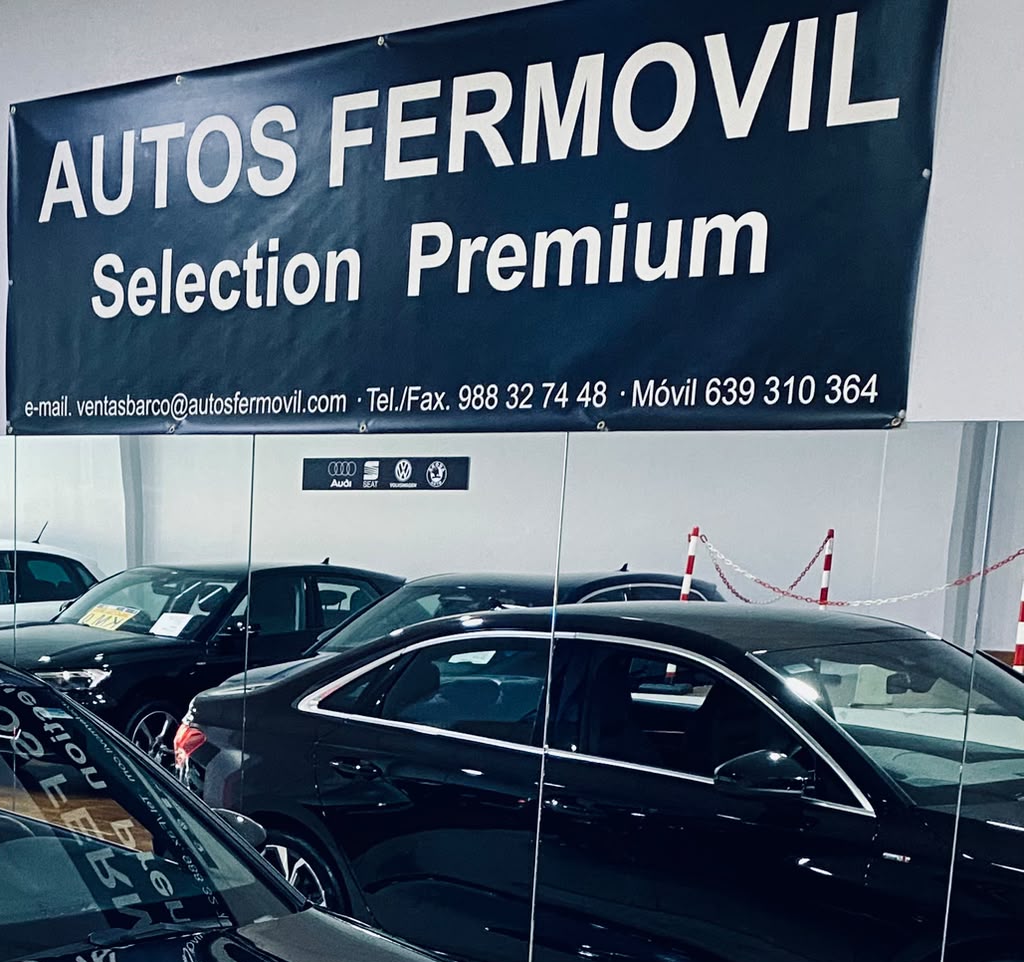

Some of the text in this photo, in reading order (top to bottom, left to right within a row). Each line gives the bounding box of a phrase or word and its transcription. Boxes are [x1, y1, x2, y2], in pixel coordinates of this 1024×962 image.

[39, 11, 900, 223] AUTOS FERMOVIL
[91, 202, 768, 319] Selection Premium
[25, 374, 878, 420] e-mail. ventasbarco@autosfermovil.com Tel./Fax. 988 32 74 48 Móvil 639 310 364
[330, 478, 352, 488] Audi
